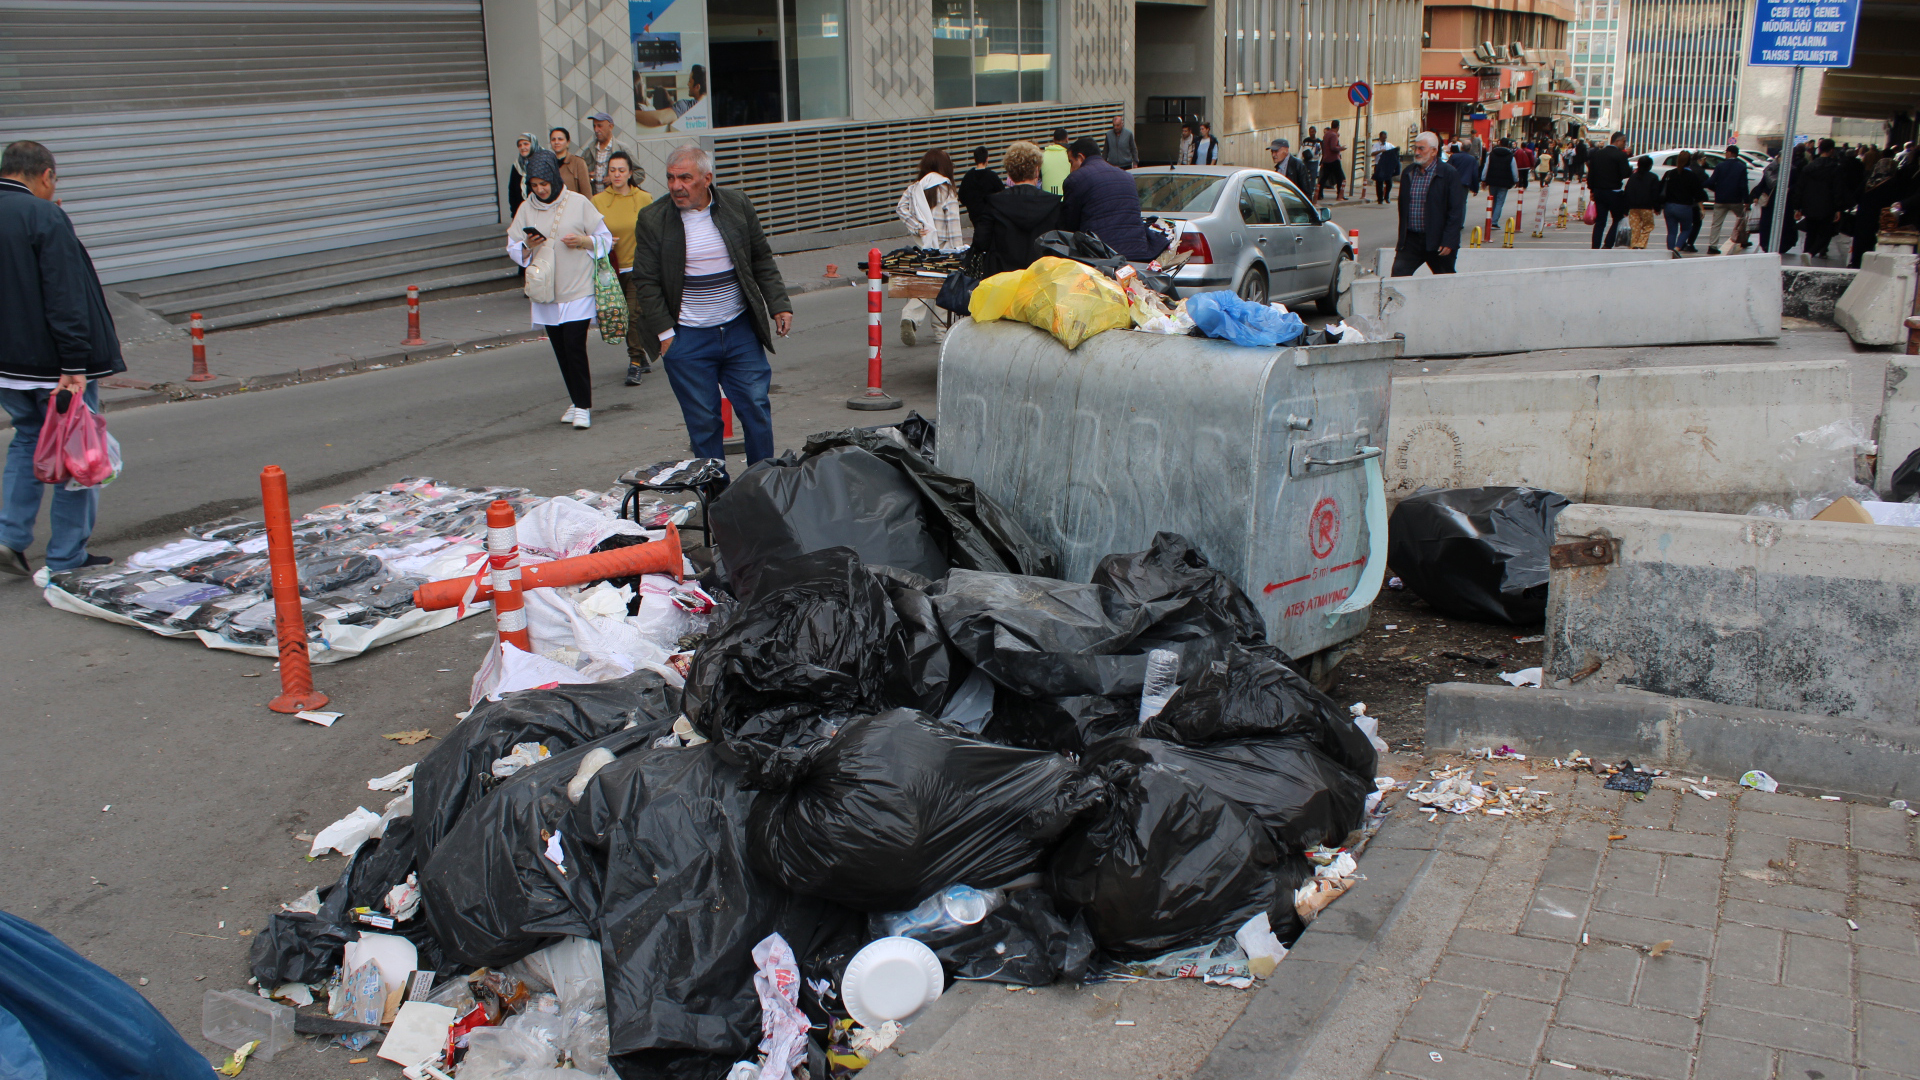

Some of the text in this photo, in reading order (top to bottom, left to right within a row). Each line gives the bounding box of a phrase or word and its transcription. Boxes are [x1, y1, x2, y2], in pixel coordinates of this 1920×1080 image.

[1771, 6, 1790, 18] CEBİ
[1813, 6, 1840, 18] GENEL
[1761, 19, 1846, 33] MÜDÜRLÜĞÜ HİZMET
[1775, 35, 1827, 49] ARAÇLARINA
[1762, 49, 1838, 63] TAHSİS EDİLMİŞTİR
[1420, 79, 1467, 93] EMİŞ
[1312, 567, 1319, 581] 5
[1284, 586, 1349, 619] ATEŞ ATMAYINIZ
